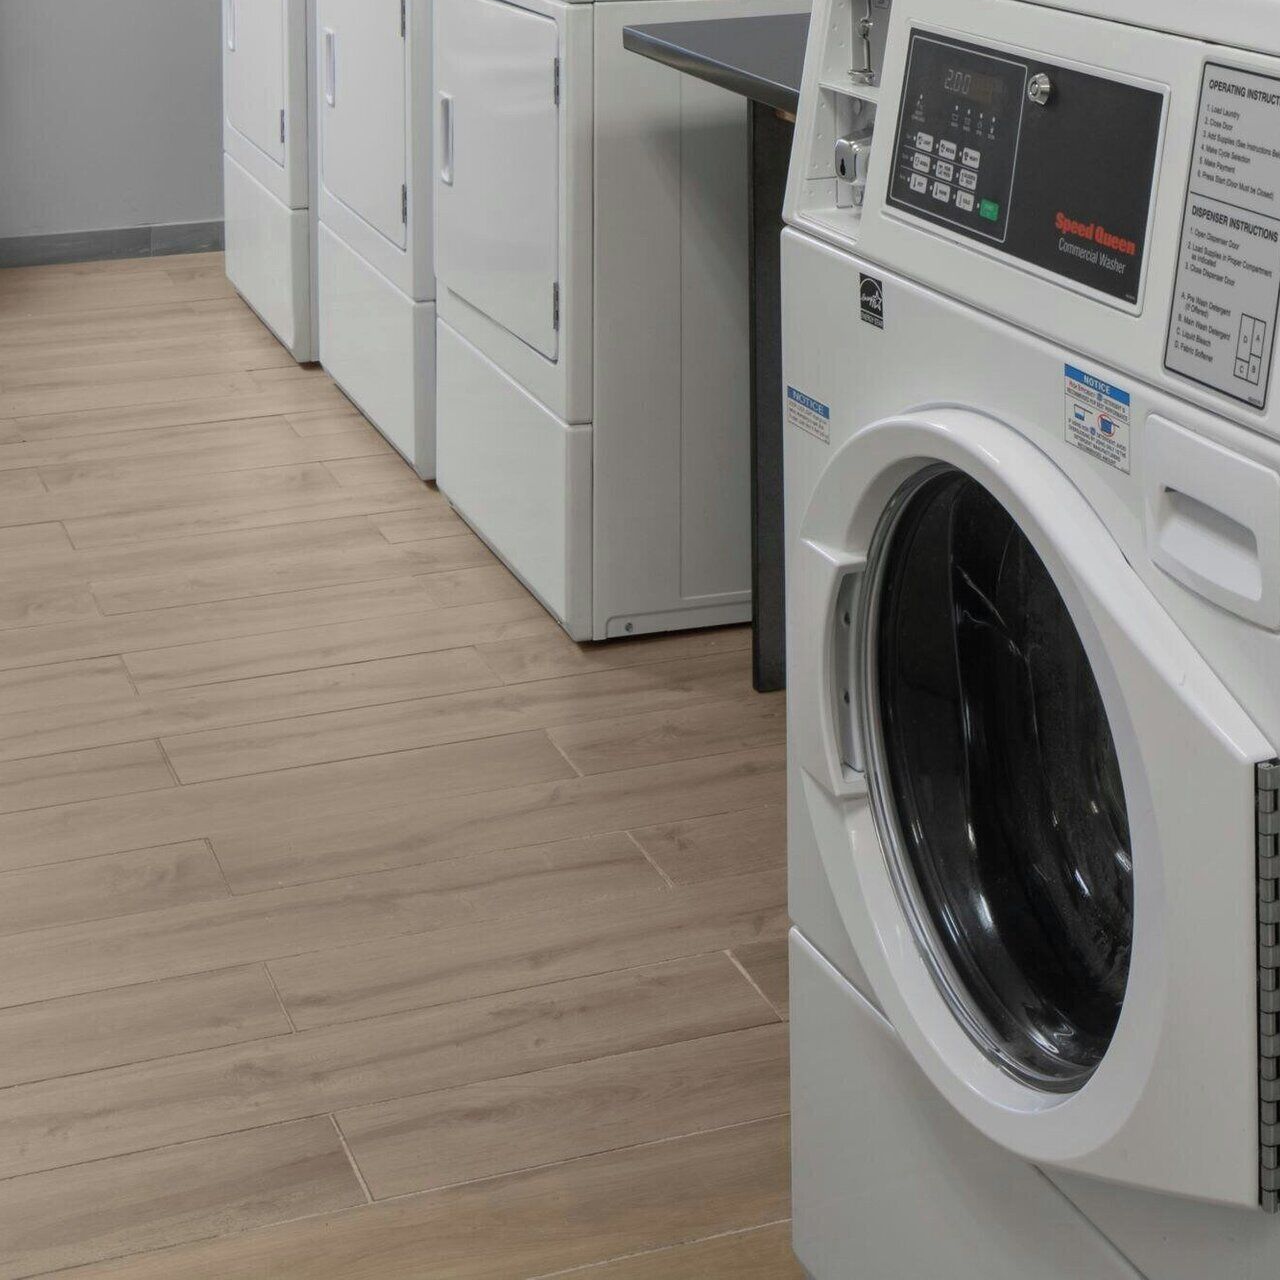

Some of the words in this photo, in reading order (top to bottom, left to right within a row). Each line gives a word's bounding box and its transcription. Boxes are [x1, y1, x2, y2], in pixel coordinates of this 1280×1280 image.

[1209, 80, 1246, 97] OPERATING
[1055, 211, 1095, 240] Speed
[1094, 225, 1136, 256] Queen
[1191, 204, 1228, 226] DISPENSER
[1229, 217, 1279, 243] INSTRUCTIONS
[1058, 237, 1098, 263] Commercial
[1099, 253, 1126, 274] Washer
[1083, 374, 1111, 395] NOTICE
